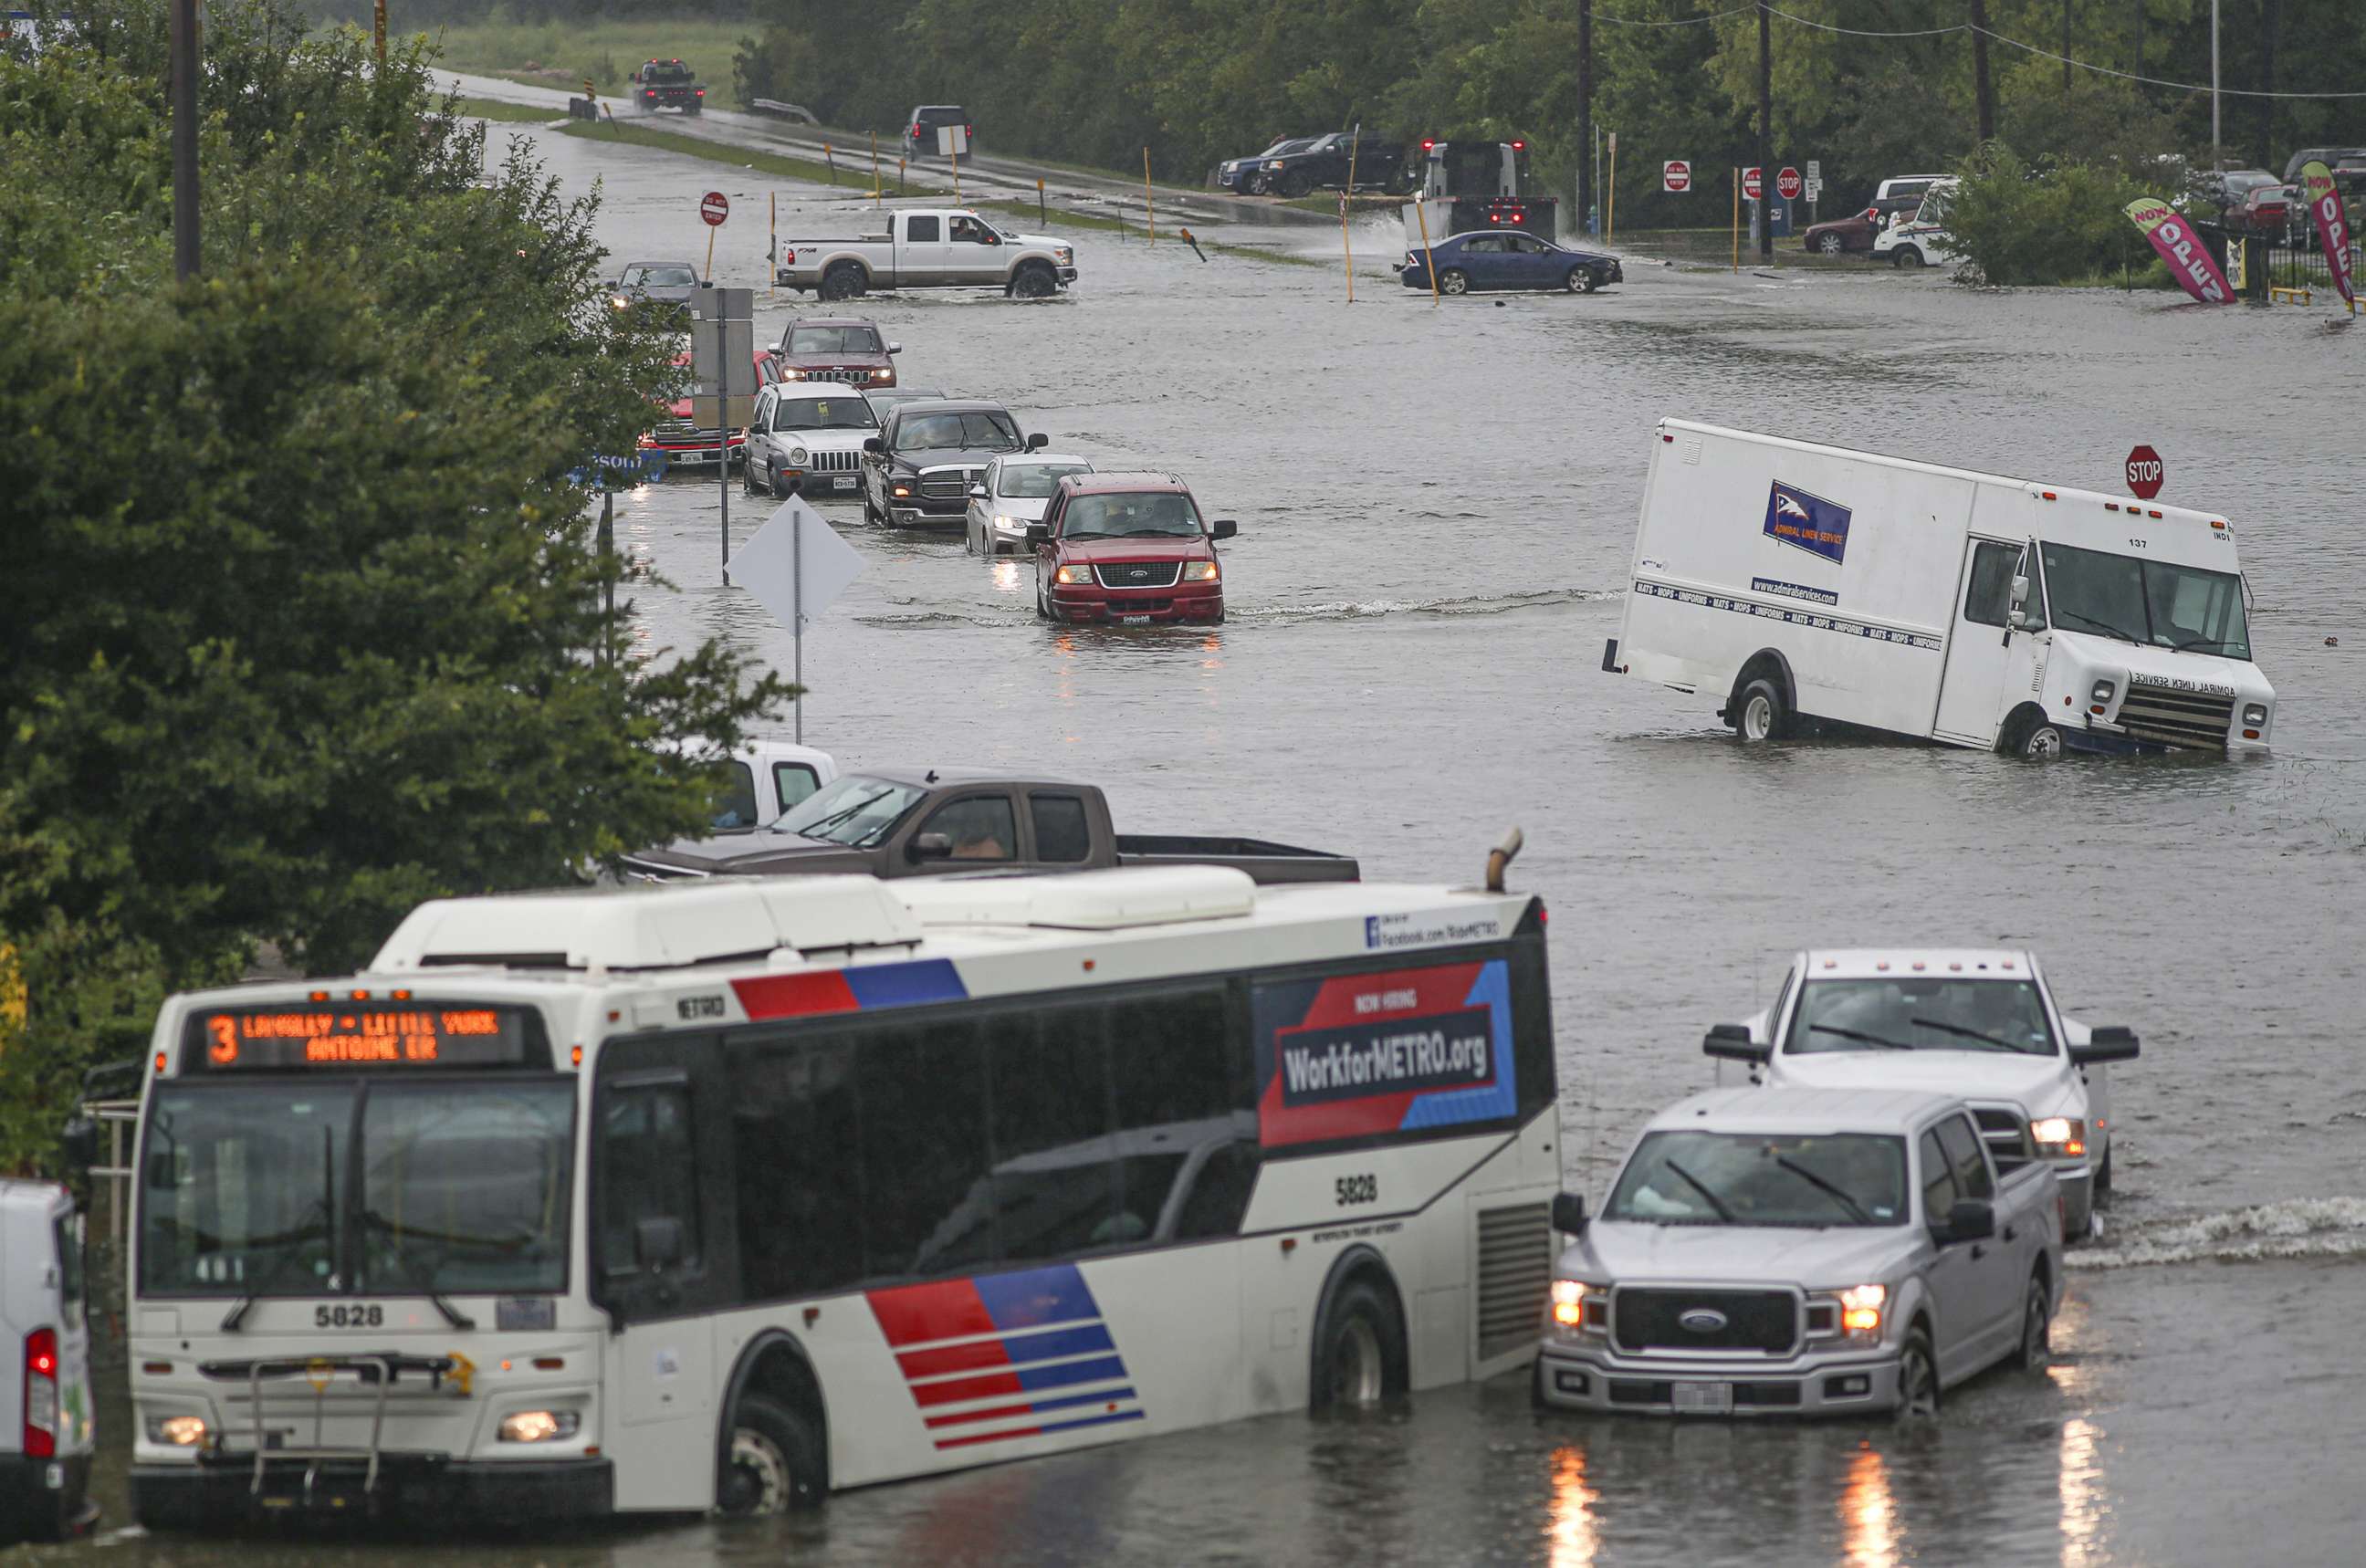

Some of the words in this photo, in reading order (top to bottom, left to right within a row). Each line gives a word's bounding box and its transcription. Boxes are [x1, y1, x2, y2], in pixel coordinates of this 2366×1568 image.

[1780, 177, 1799, 190] STOP
[2308, 176, 2331, 189] NOW
[2134, 205, 2169, 224] NOW
[2158, 223, 2225, 303] OPEN
[2129, 461, 2161, 483] STOP
[1774, 524, 1800, 538] ADMIRAL
[1819, 532, 1843, 545] SERVICE
[2129, 538, 2147, 549] 137
[1754, 580, 1837, 605] www.admiralservices.com
[1637, 583, 1653, 595] MATS
[1657, 587, 1674, 599] MOPS
[1679, 591, 1707, 605] UNIFORMS
[1713, 598, 1730, 610] MATS
[1733, 602, 1751, 613] MOPS
[1754, 606, 1785, 621] UNIFORMS
[1792, 613, 1808, 625] MATS
[1813, 617, 1830, 629] MOPS
[1835, 622, 1864, 636] UNIFORMS
[1869, 629, 1887, 640] MATS
[1890, 632, 1909, 644] MOPS
[1913, 637, 1942, 650] UNIFORMS
[1355, 993, 1381, 1014] NOW
[208, 1014, 238, 1064] 3
[1283, 1030, 1488, 1093] WorkforMETRO.org
[1335, 1174, 1378, 1207] 5828
[314, 1304, 384, 1329] 5828
